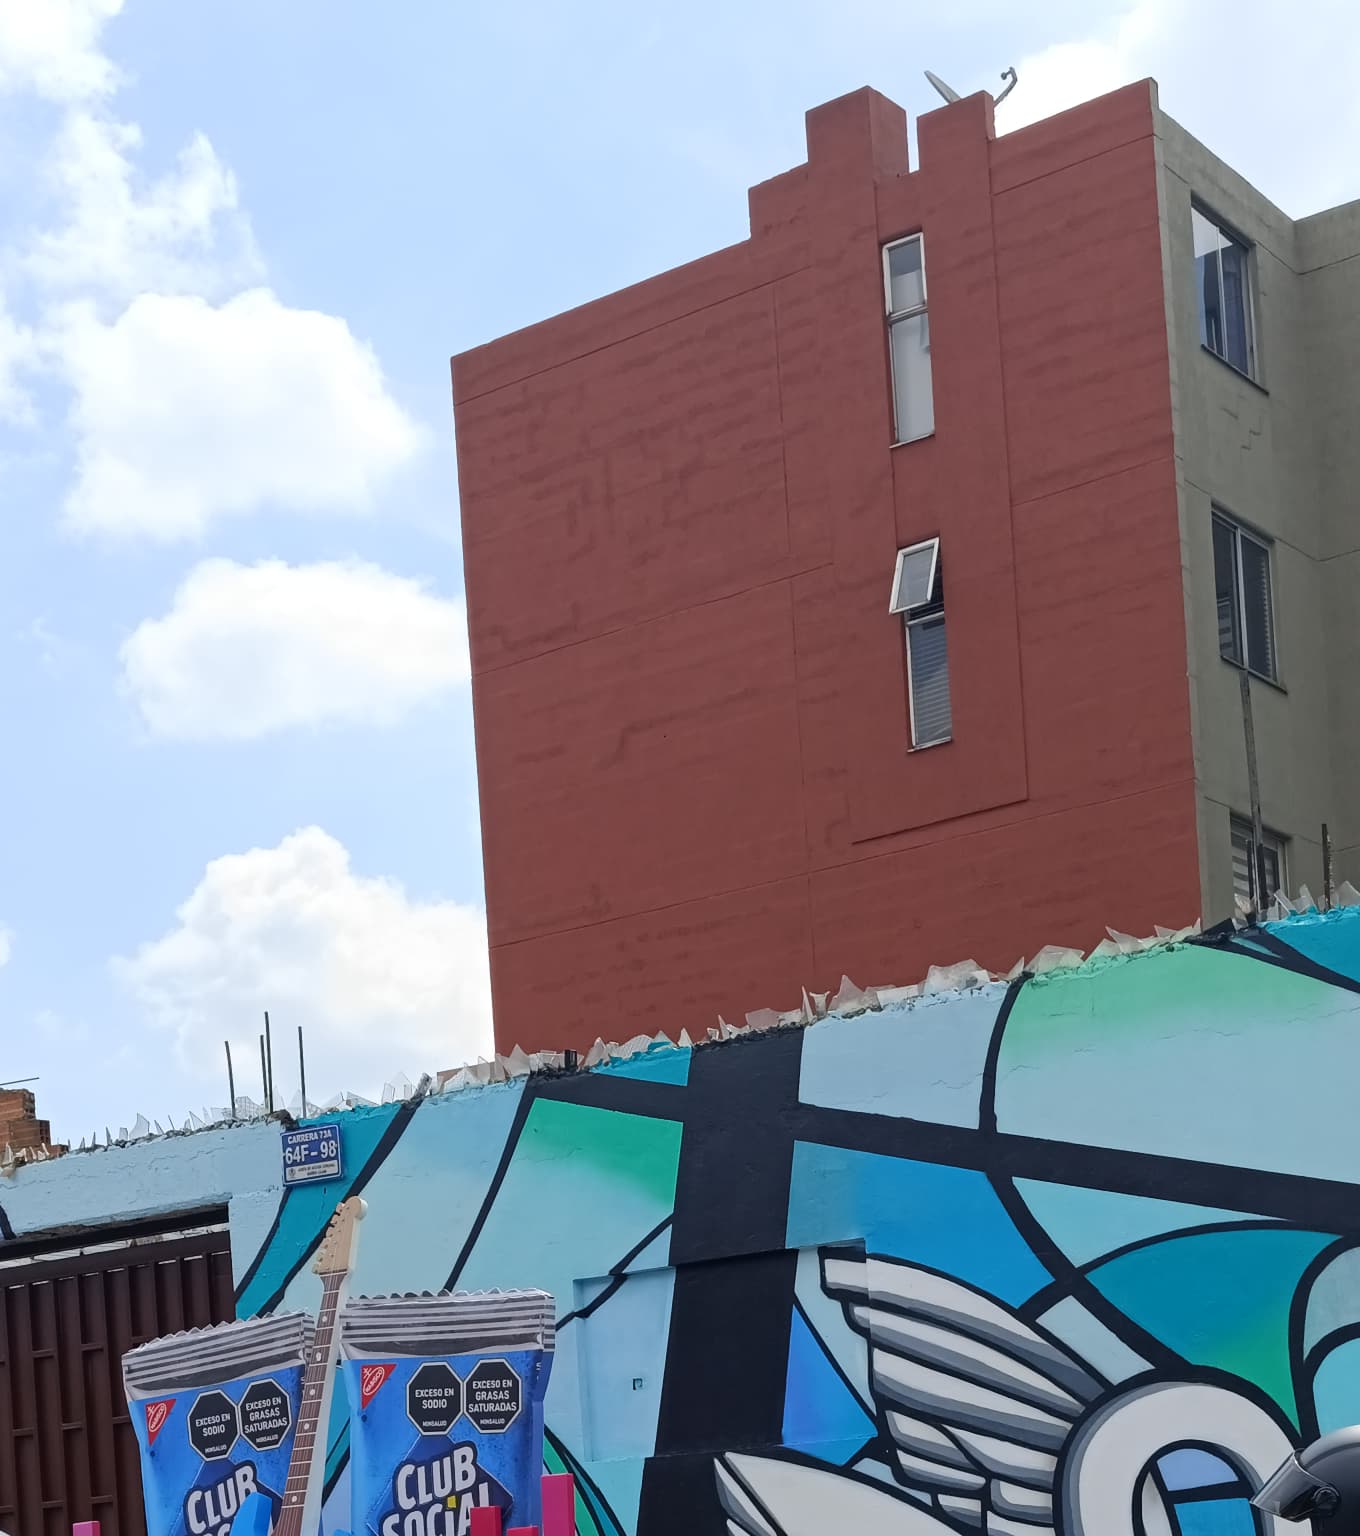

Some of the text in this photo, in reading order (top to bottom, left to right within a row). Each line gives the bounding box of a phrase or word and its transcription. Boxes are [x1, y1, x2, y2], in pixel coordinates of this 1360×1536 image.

[287, 1129, 333, 1144] CARRERA 73A
[472, 1379, 513, 1390] EXCESO EN
[415, 1387, 455, 1398] EXCESO EN
[475, 1390, 510, 1401] GRASAS
[246, 1397, 282, 1411] EXCESO EN
[422, 1399, 447, 1409] SODIO
[468, 1402, 517, 1413] SATURADAS
[195, 1413, 231, 1427] EXCESO EN
[249, 1407, 280, 1421] GRASAS
[202, 1425, 226, 1437] SODIO
[244, 1417, 288, 1434] SATURADAS
[397, 1446, 477, 1511] CLUB
[188, 1465, 258, 1534] CLUB
